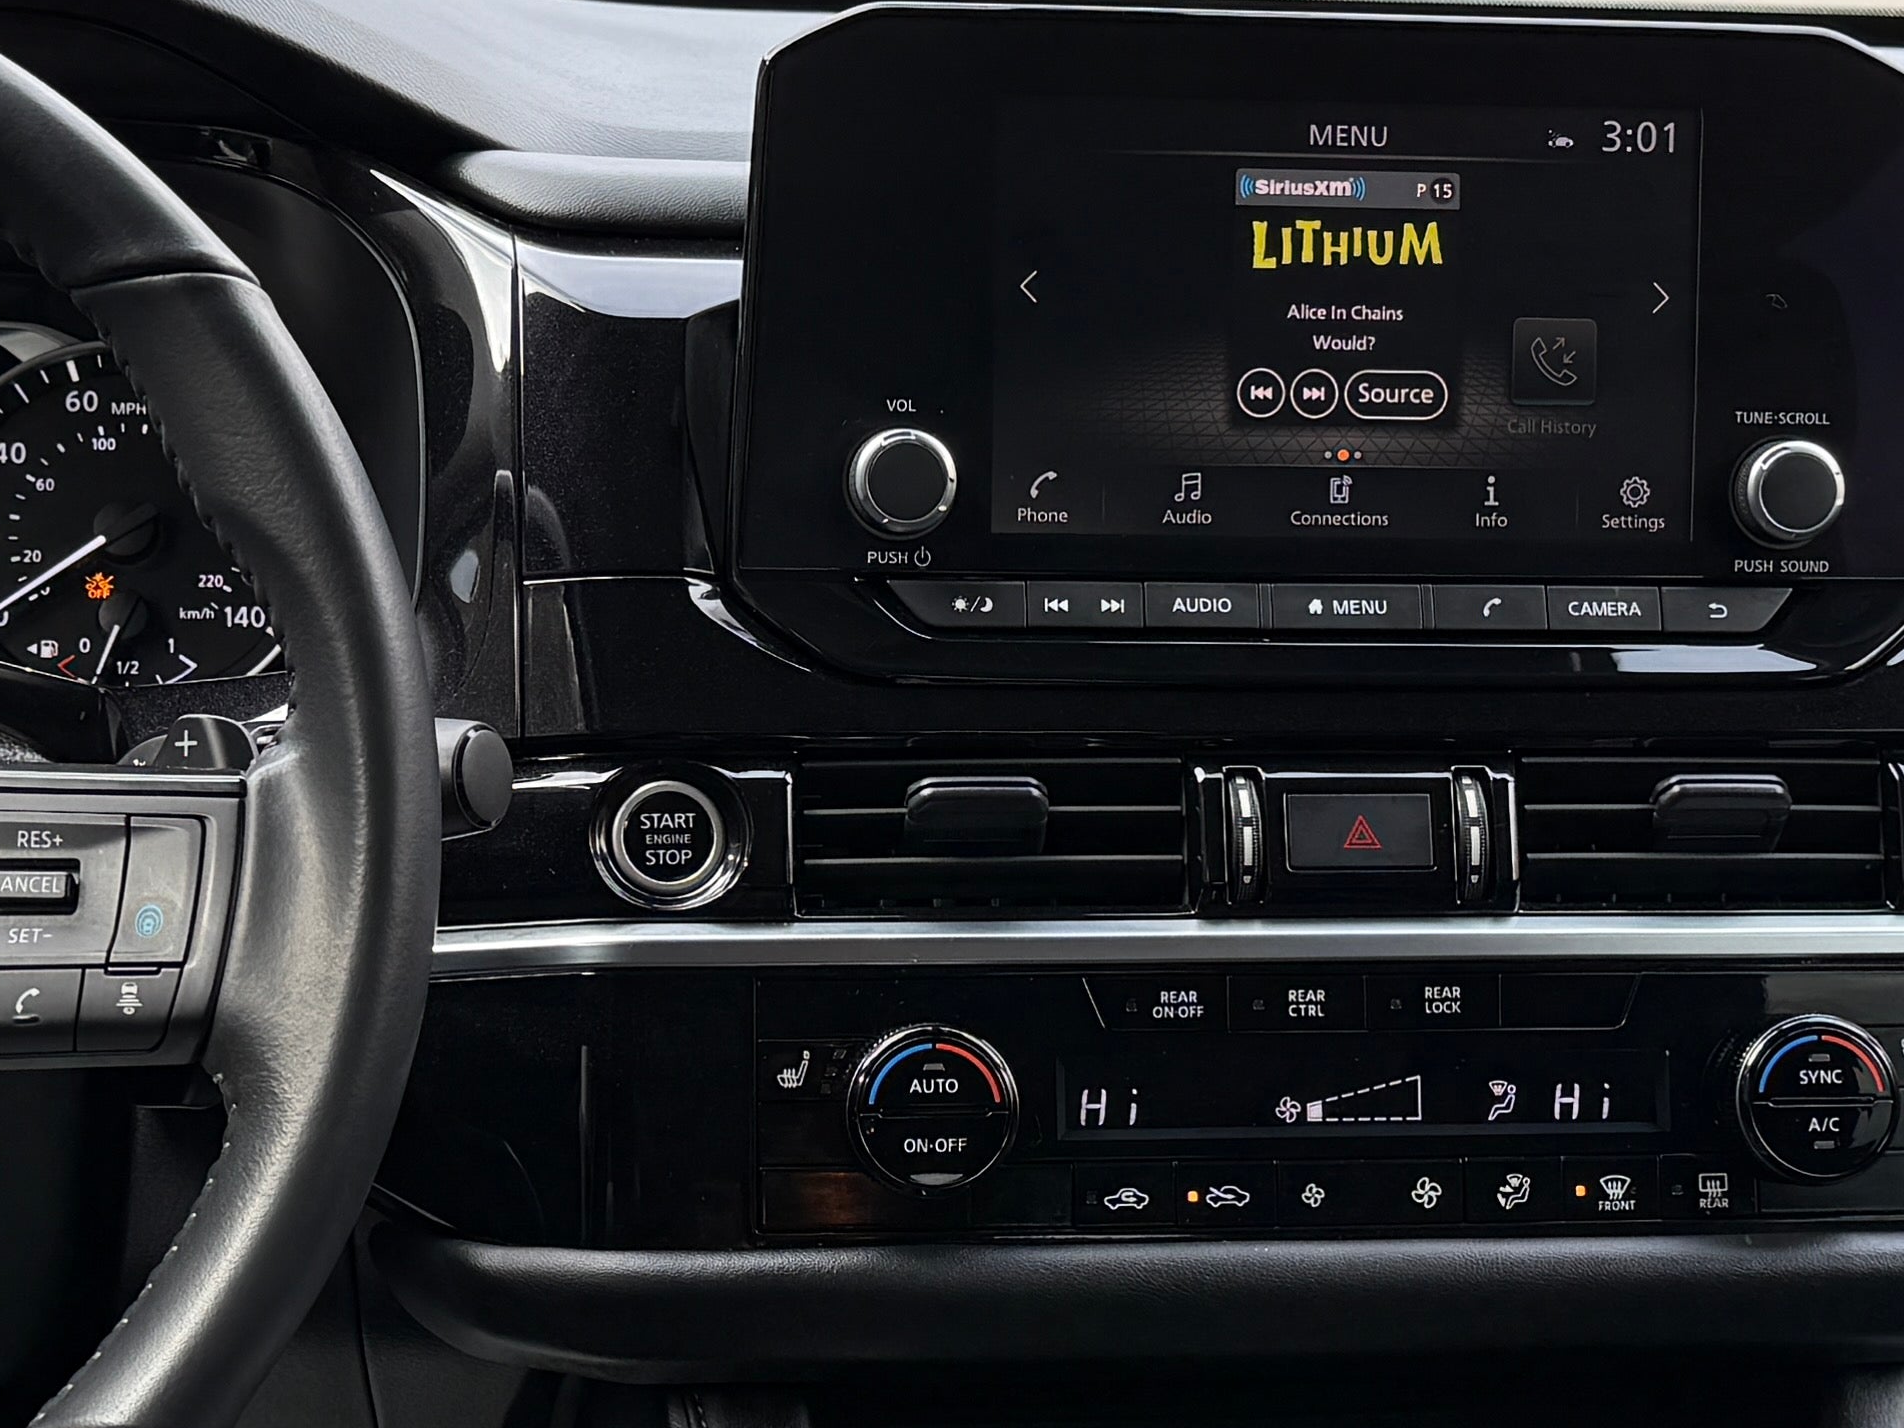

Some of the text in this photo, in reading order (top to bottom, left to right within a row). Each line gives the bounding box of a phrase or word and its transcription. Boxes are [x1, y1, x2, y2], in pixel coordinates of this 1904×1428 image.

[1309, 124, 1388, 147] MENU
[1601, 120, 1676, 153] 3:01
[1416, 183, 1453, 199] P 15
[1287, 304, 1404, 322] Alice In Chains
[1313, 334, 1376, 352] Would?
[64, 390, 99, 413] 60
[1358, 383, 1434, 404] Source
[111, 401, 147, 415] MPH
[886, 399, 917, 413] VOL
[1507, 419, 1597, 439] Call History
[91, 437, 116, 451] 100
[35, 478, 55, 492] 60
[1017, 507, 1069, 522] Phone
[1162, 509, 1212, 525] Audio
[1290, 510, 1389, 527] Connections
[1475, 512, 1508, 528] Info
[1601, 514, 1665, 532] Settings
[23, 550, 42, 563] 20
[867, 551, 908, 564] PUSH
[1734, 559, 1830, 573] PUSH SOUND
[198, 575, 224, 588] 220
[179, 606, 215, 620] km/h
[1172, 597, 1232, 613] AUDIO
[1332, 599, 1388, 615] MENU
[1568, 600, 1641, 617] CAMERA
[224, 606, 266, 628] 140
[79, 638, 91, 653] 0
[167, 638, 175, 653] 1
[116, 661, 139, 675] 1/2
[640, 813, 696, 829] START
[16, 830, 64, 848] RES+
[646, 834, 692, 845] ENGINE
[645, 849, 693, 865] STOP
[1160, 990, 1198, 1004] REAR
[1288, 989, 1326, 1003] REAR
[1424, 986, 1461, 999] REAR
[1288, 1004, 1325, 1017] CTRL
[1425, 1000, 1461, 1014] LOCK
[1799, 1069, 1843, 1085] SYNC
[909, 1078, 959, 1094] AUTO
[1807, 1117, 1840, 1133] A/C
[1598, 1199, 1636, 1212] FRONT
[1698, 1198, 1729, 1210] REAR
